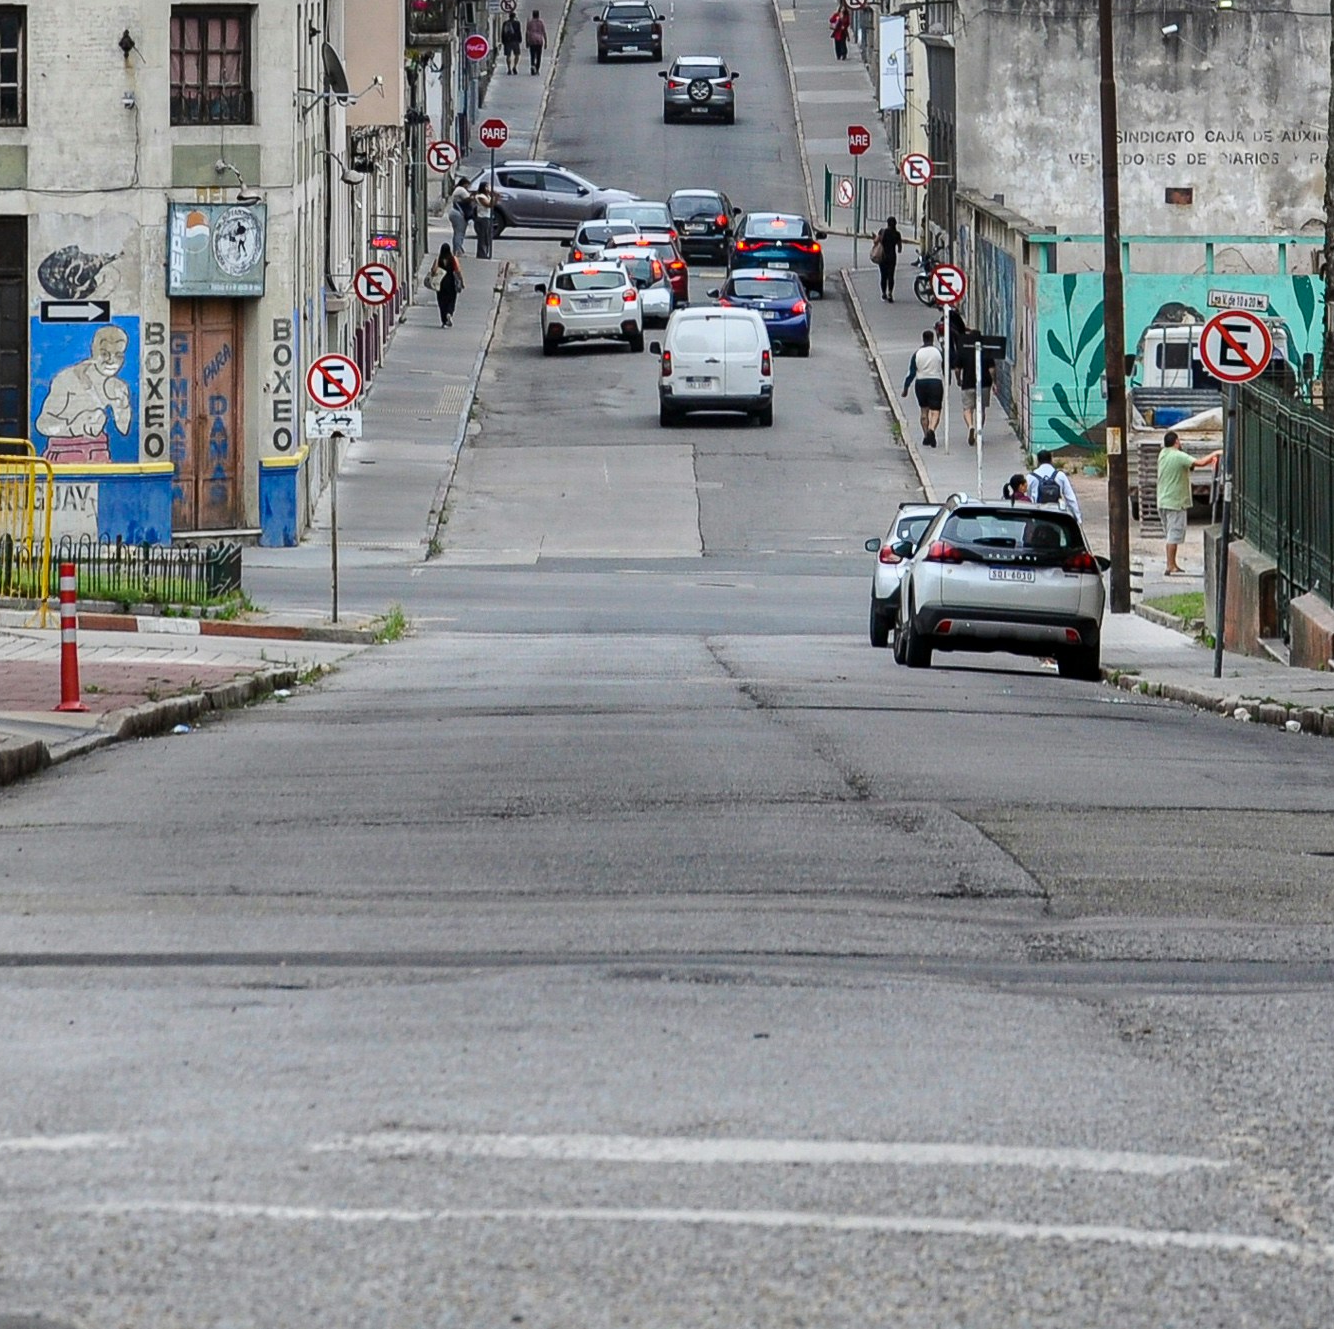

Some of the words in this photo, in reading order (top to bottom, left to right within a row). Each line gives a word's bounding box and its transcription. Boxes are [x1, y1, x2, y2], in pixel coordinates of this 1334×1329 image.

[481, 127, 507, 140] PARE
[848, 134, 869, 146] ARE
[1116, 130, 1195, 144] SINDICATO
[1204, 130, 1245, 144] CAJA
[1253, 130, 1273, 143] DE
[1186, 153, 1207, 166] DE
[202, 342, 233, 387] PARA
[144, 321, 165, 458] BOXEO
[272, 317, 293, 452] BOXEO
